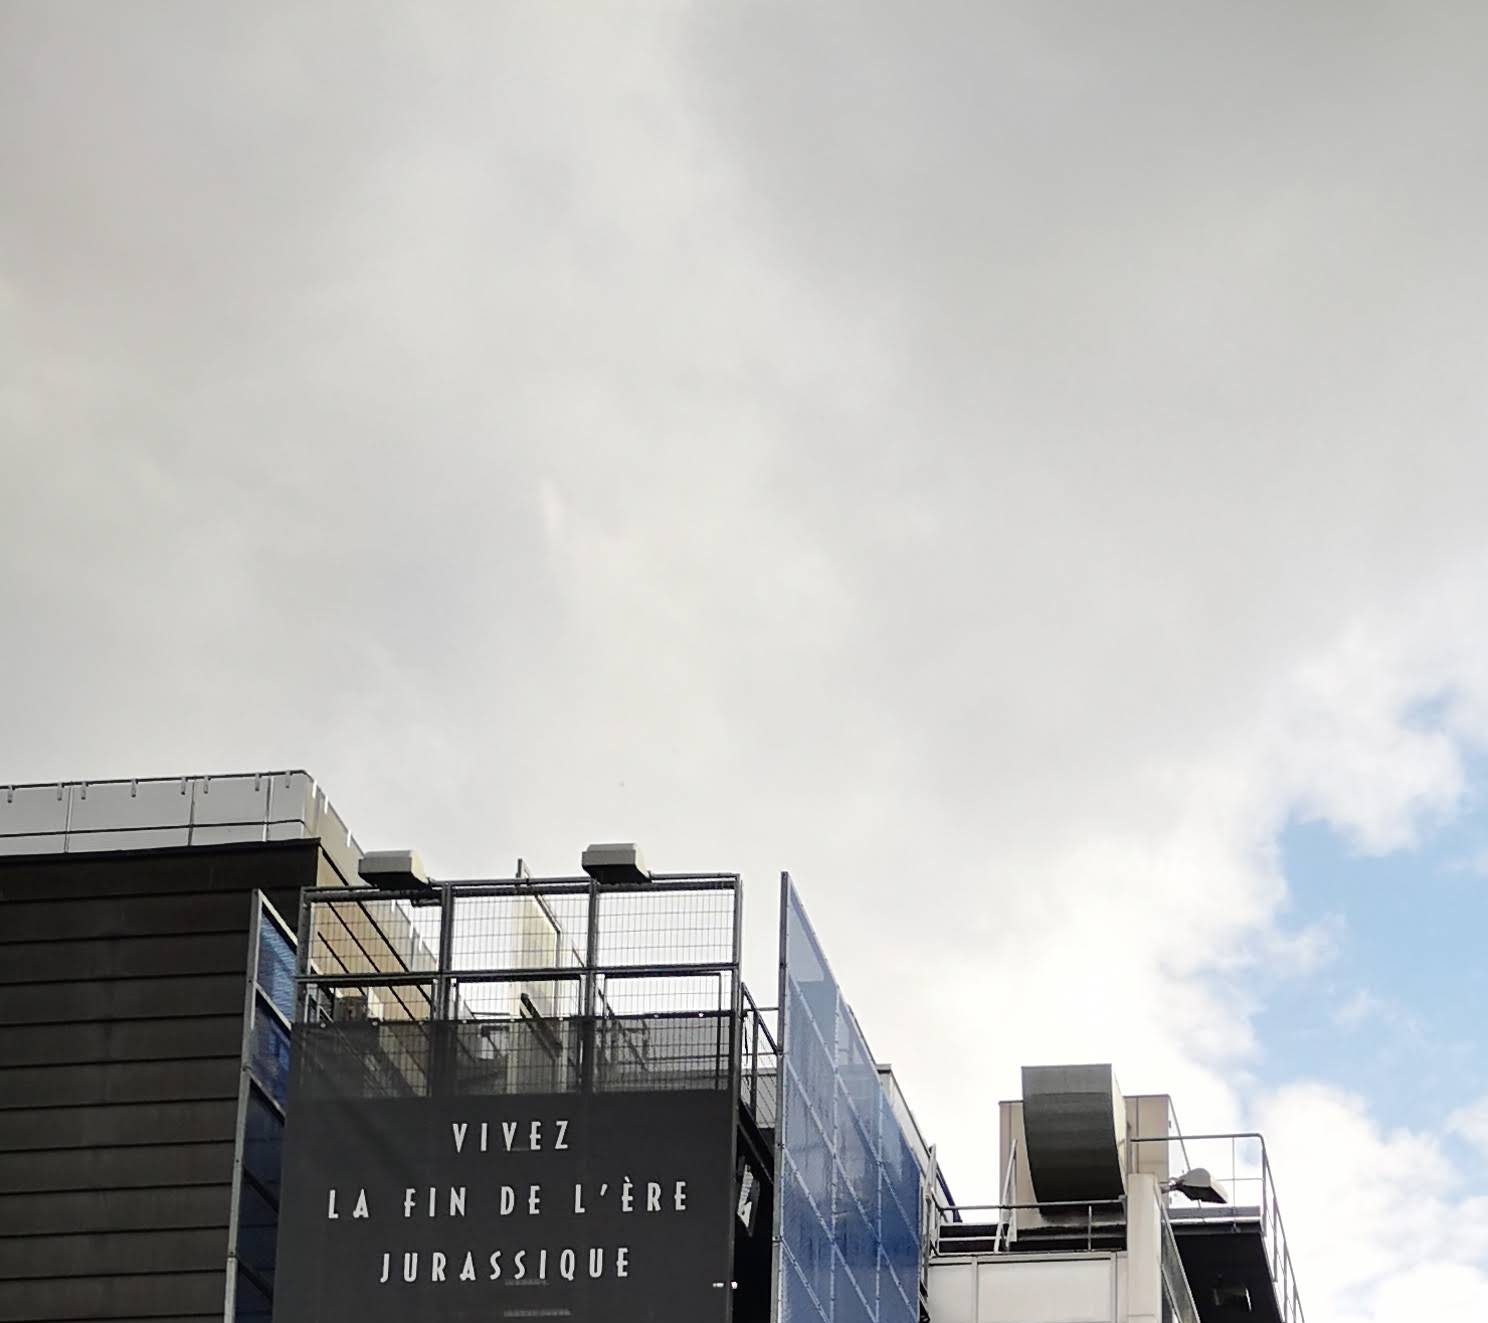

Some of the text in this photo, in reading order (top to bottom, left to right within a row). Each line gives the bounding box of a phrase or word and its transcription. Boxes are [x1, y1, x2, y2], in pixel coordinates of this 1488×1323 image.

[452, 1120, 569, 1153] VIVEZ
[328, 1175, 687, 1219] LA FIN DE L'ÈRE
[380, 1247, 629, 1283] JURASSIQUE
